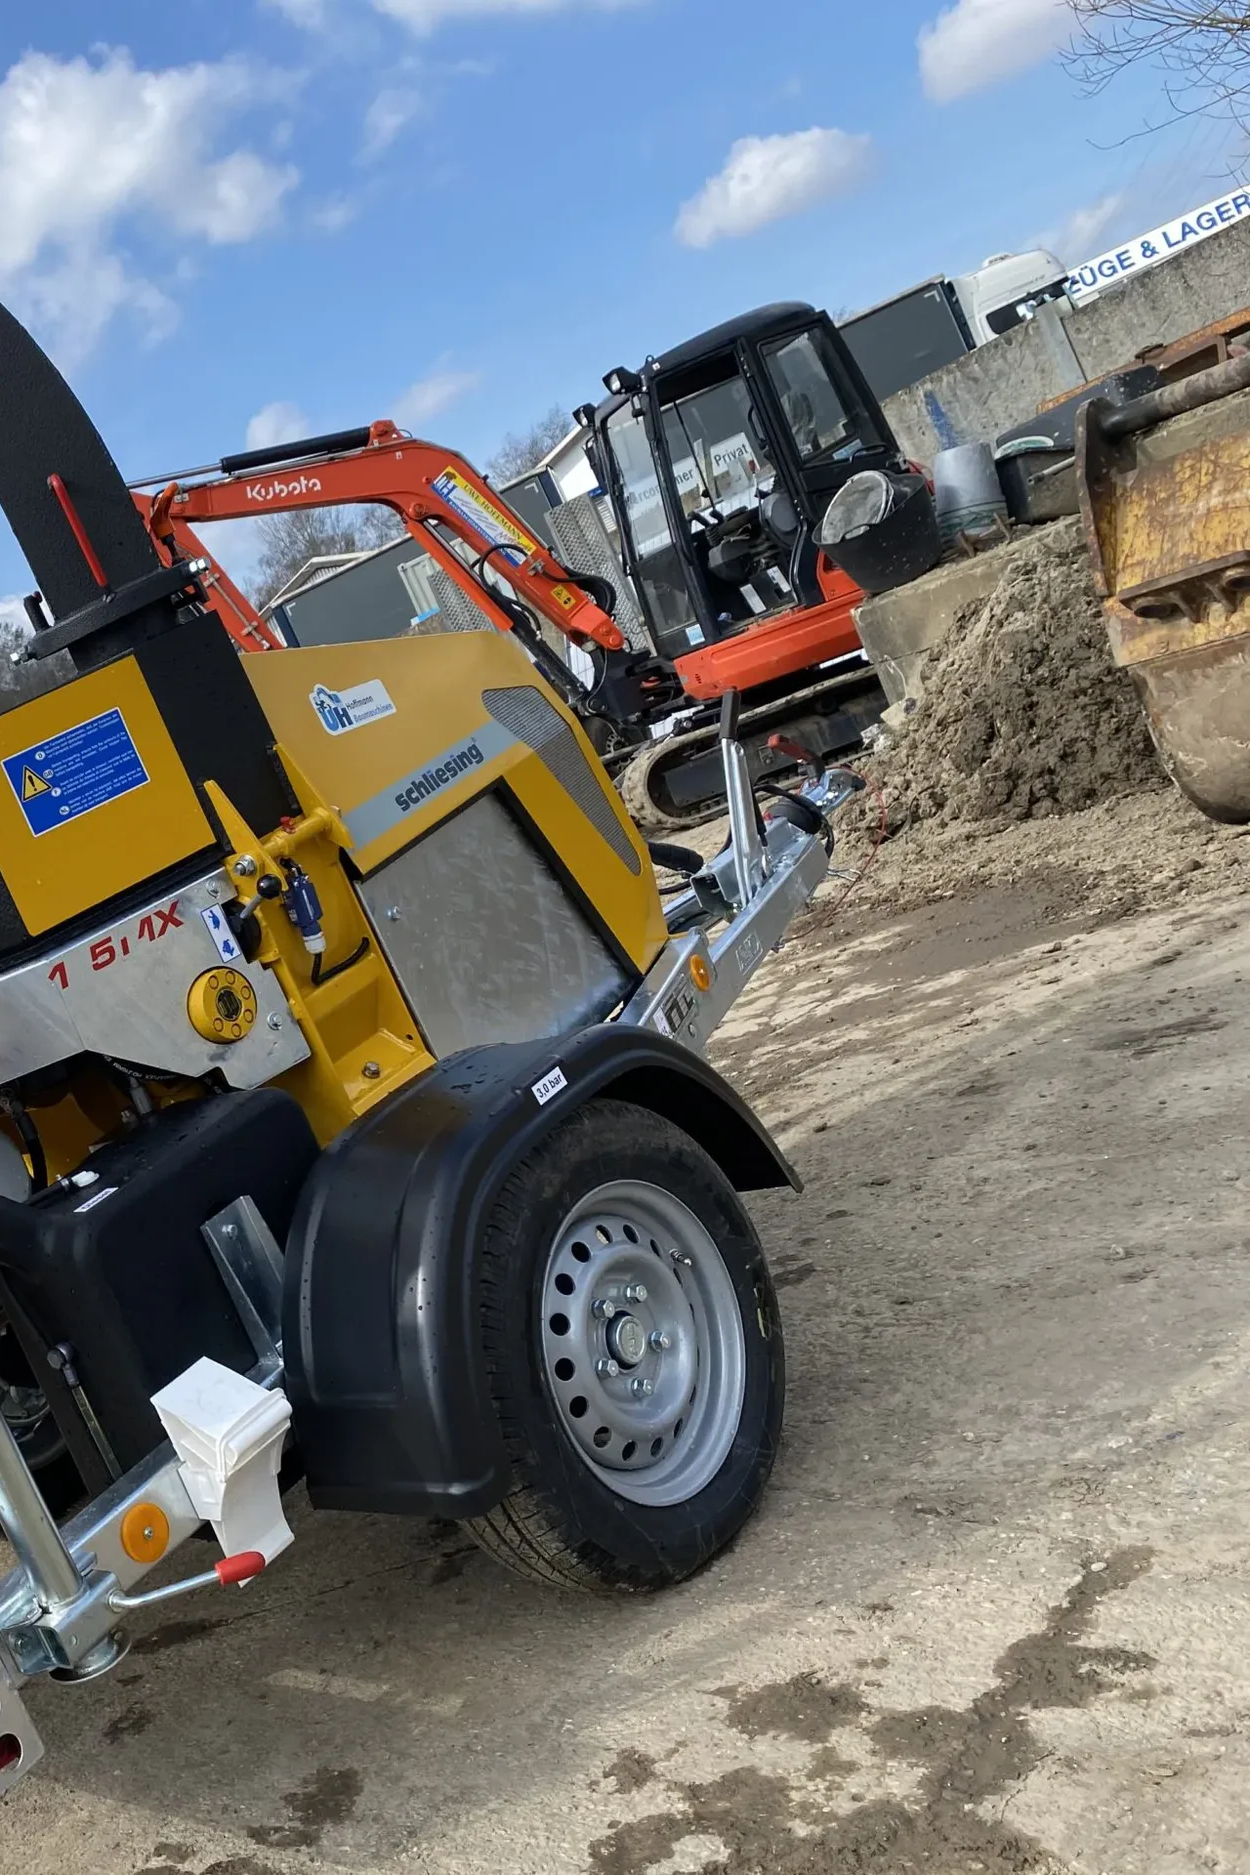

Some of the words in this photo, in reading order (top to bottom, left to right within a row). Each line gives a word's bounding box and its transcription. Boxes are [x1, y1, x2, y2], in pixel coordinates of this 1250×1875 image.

[1141, 240, 1160, 259] &
[1162, 193, 1250, 249] LAGER
[713, 443, 749, 467] Privat
[246, 476, 321, 501] Kubota
[481, 500, 522, 540] HOFFMANN
[346, 695, 373, 711] Hoffmann
[353, 703, 394, 724] Baumaschinen
[394, 743, 484, 812] schliesing
[536, 1083, 551, 1098] 3,0
[549, 1073, 563, 1089] bar
